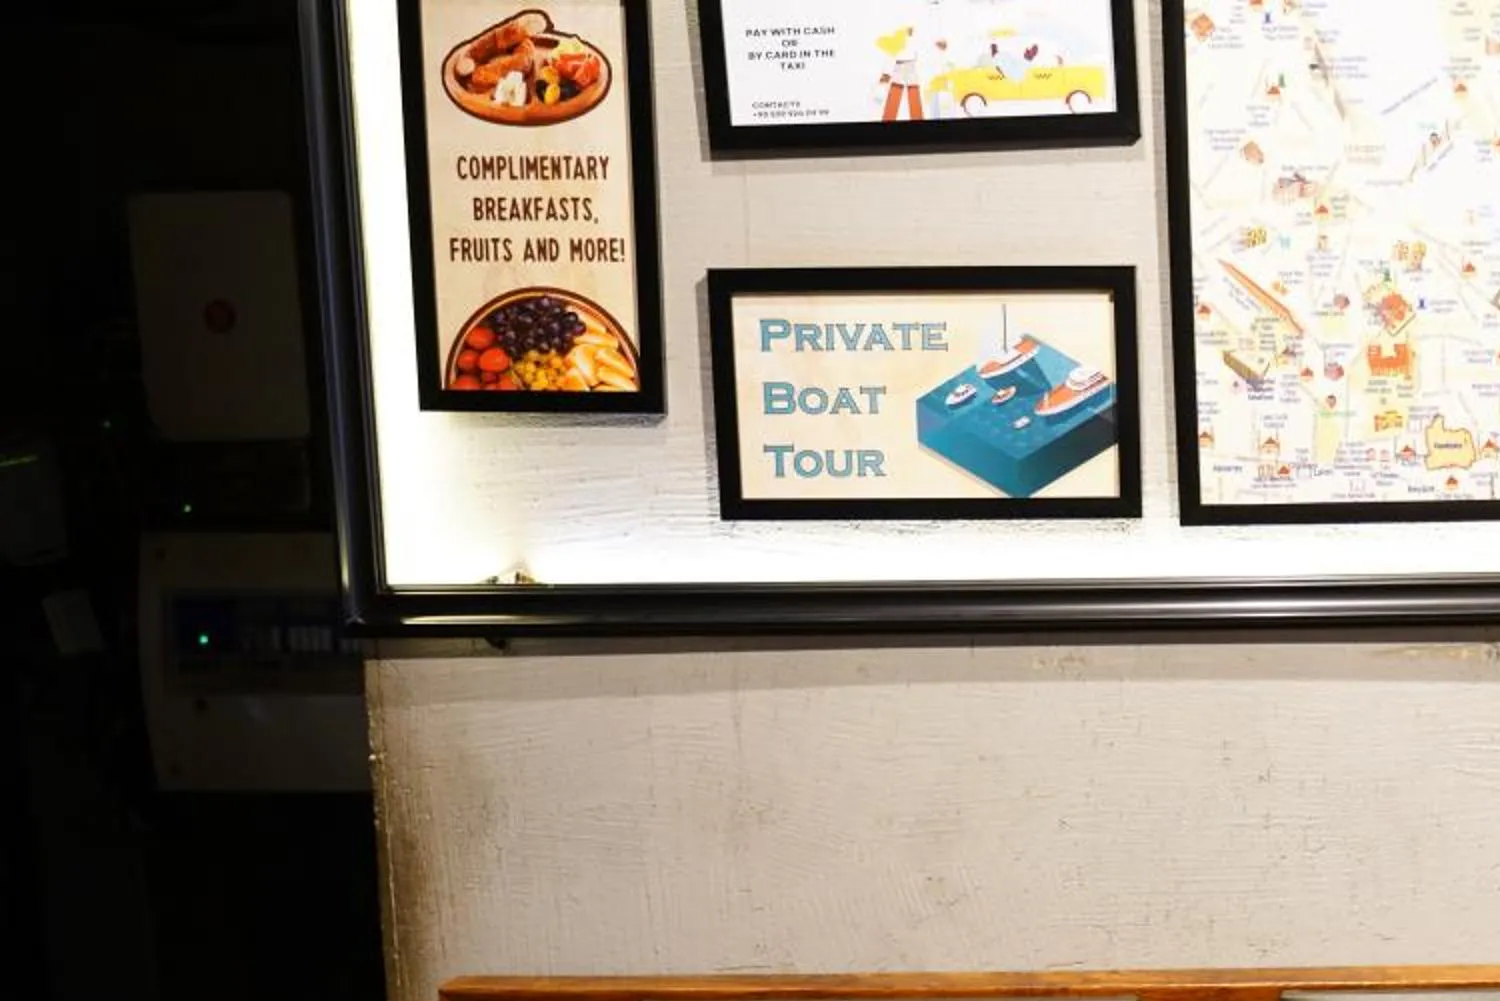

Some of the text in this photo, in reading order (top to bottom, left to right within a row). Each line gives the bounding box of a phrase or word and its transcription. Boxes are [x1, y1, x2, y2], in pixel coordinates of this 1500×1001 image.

[745, 26, 835, 37] PAY WITH CASH
[747, 49, 834, 60] BY CARD IN THE
[780, 62, 805, 70] TAXI
[456, 155, 609, 182] COMPLIMENTARY
[472, 197, 599, 224] BREAKFASTS,
[449, 237, 625, 263] FRUITS AND MORE!
[759, 318, 949, 353] PRIVATE
[762, 381, 887, 416] BOAT
[762, 443, 887, 479] TOUR
